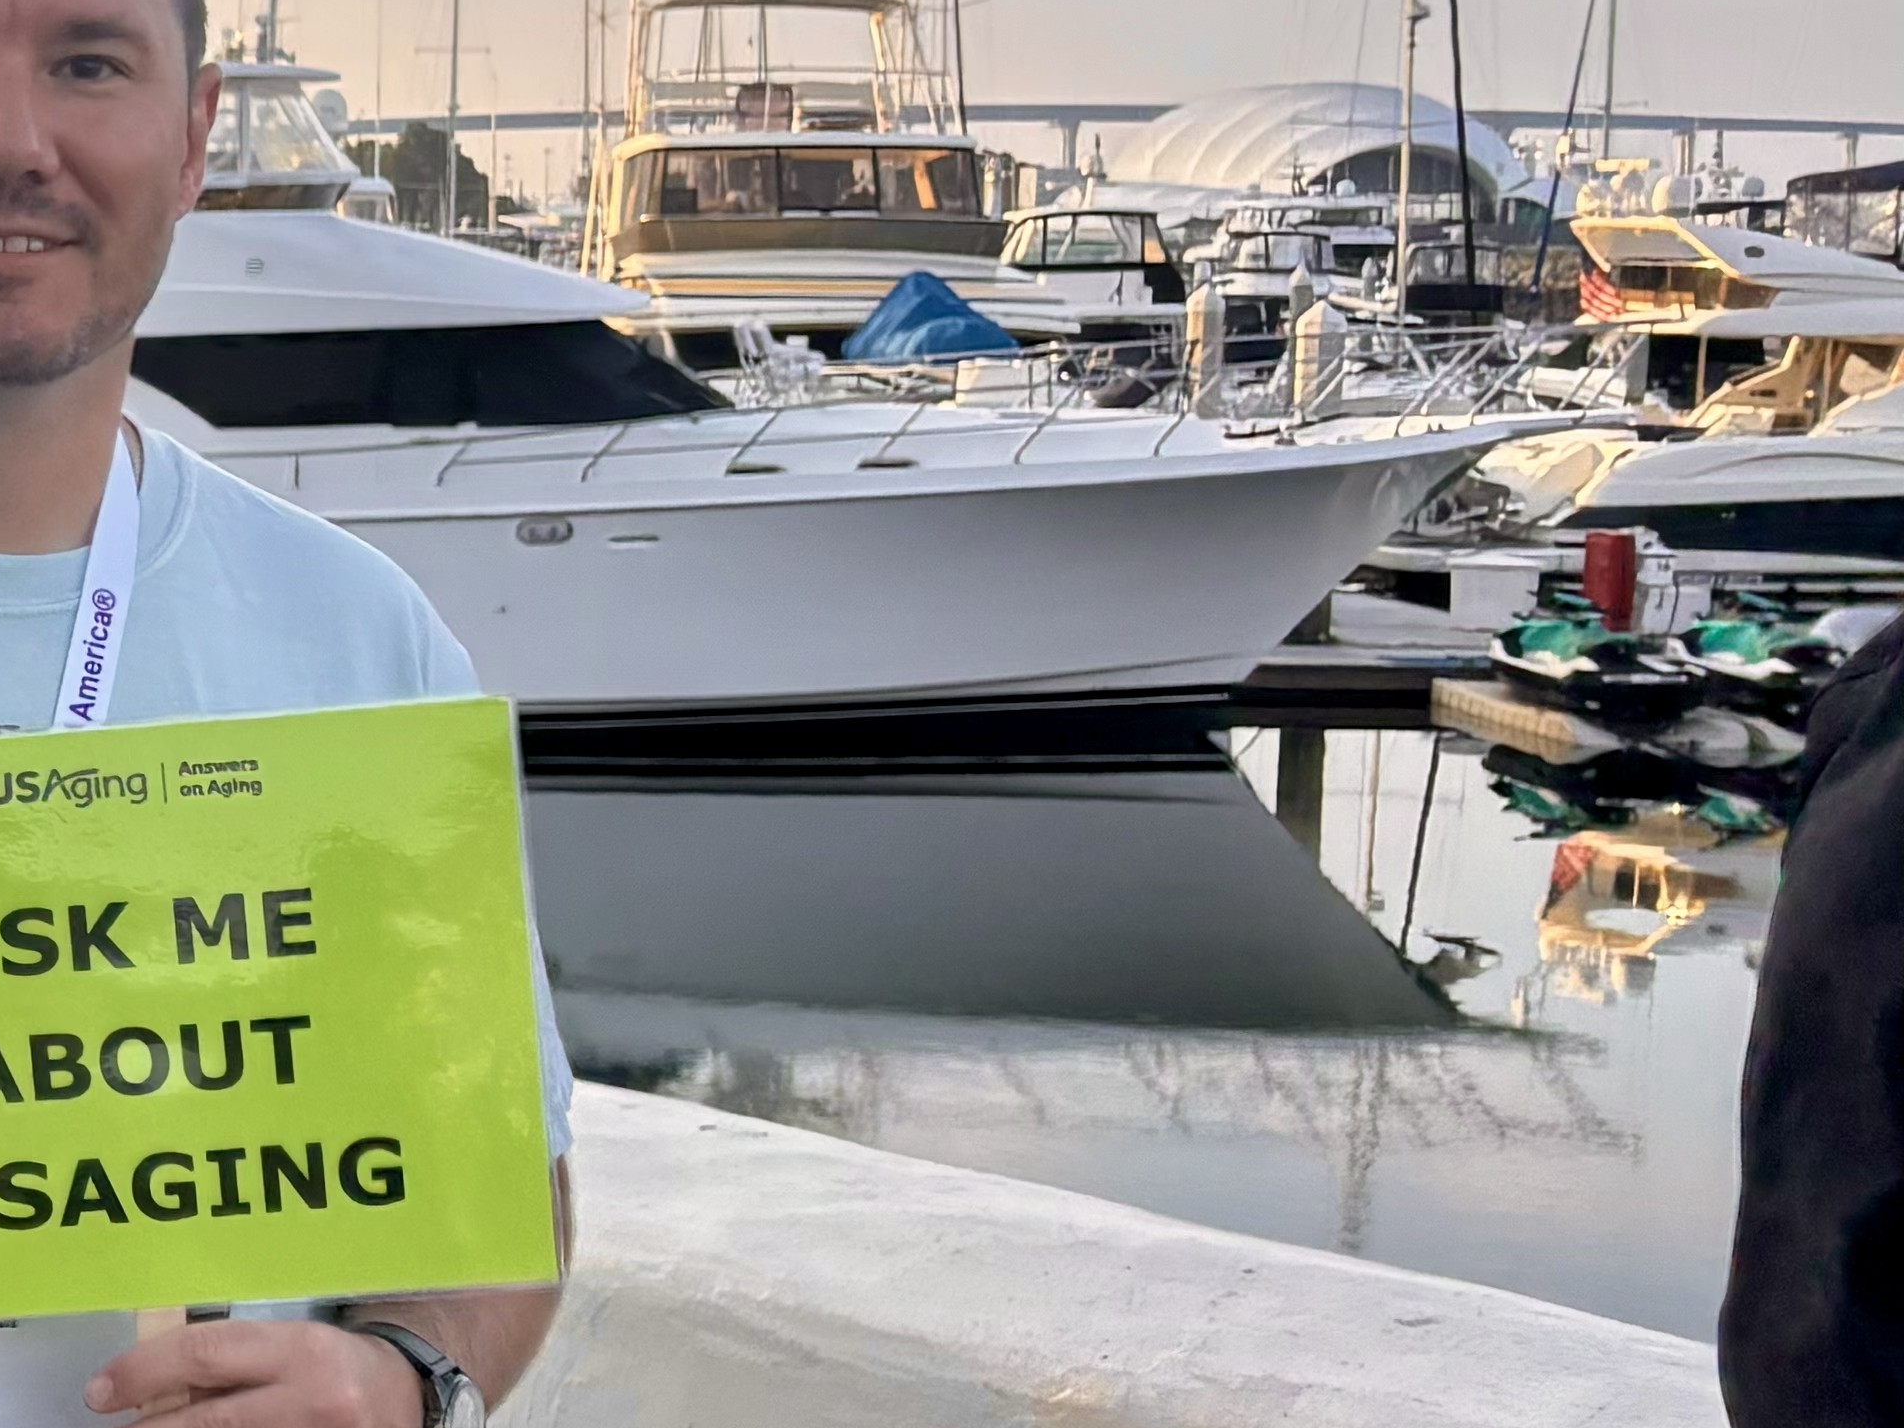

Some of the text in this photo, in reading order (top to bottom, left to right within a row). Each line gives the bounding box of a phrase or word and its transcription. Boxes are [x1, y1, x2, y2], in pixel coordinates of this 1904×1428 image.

[179, 759, 259, 777] Answers
[180, 778, 263, 798] on Aging
[173, 887, 317, 964] ME
